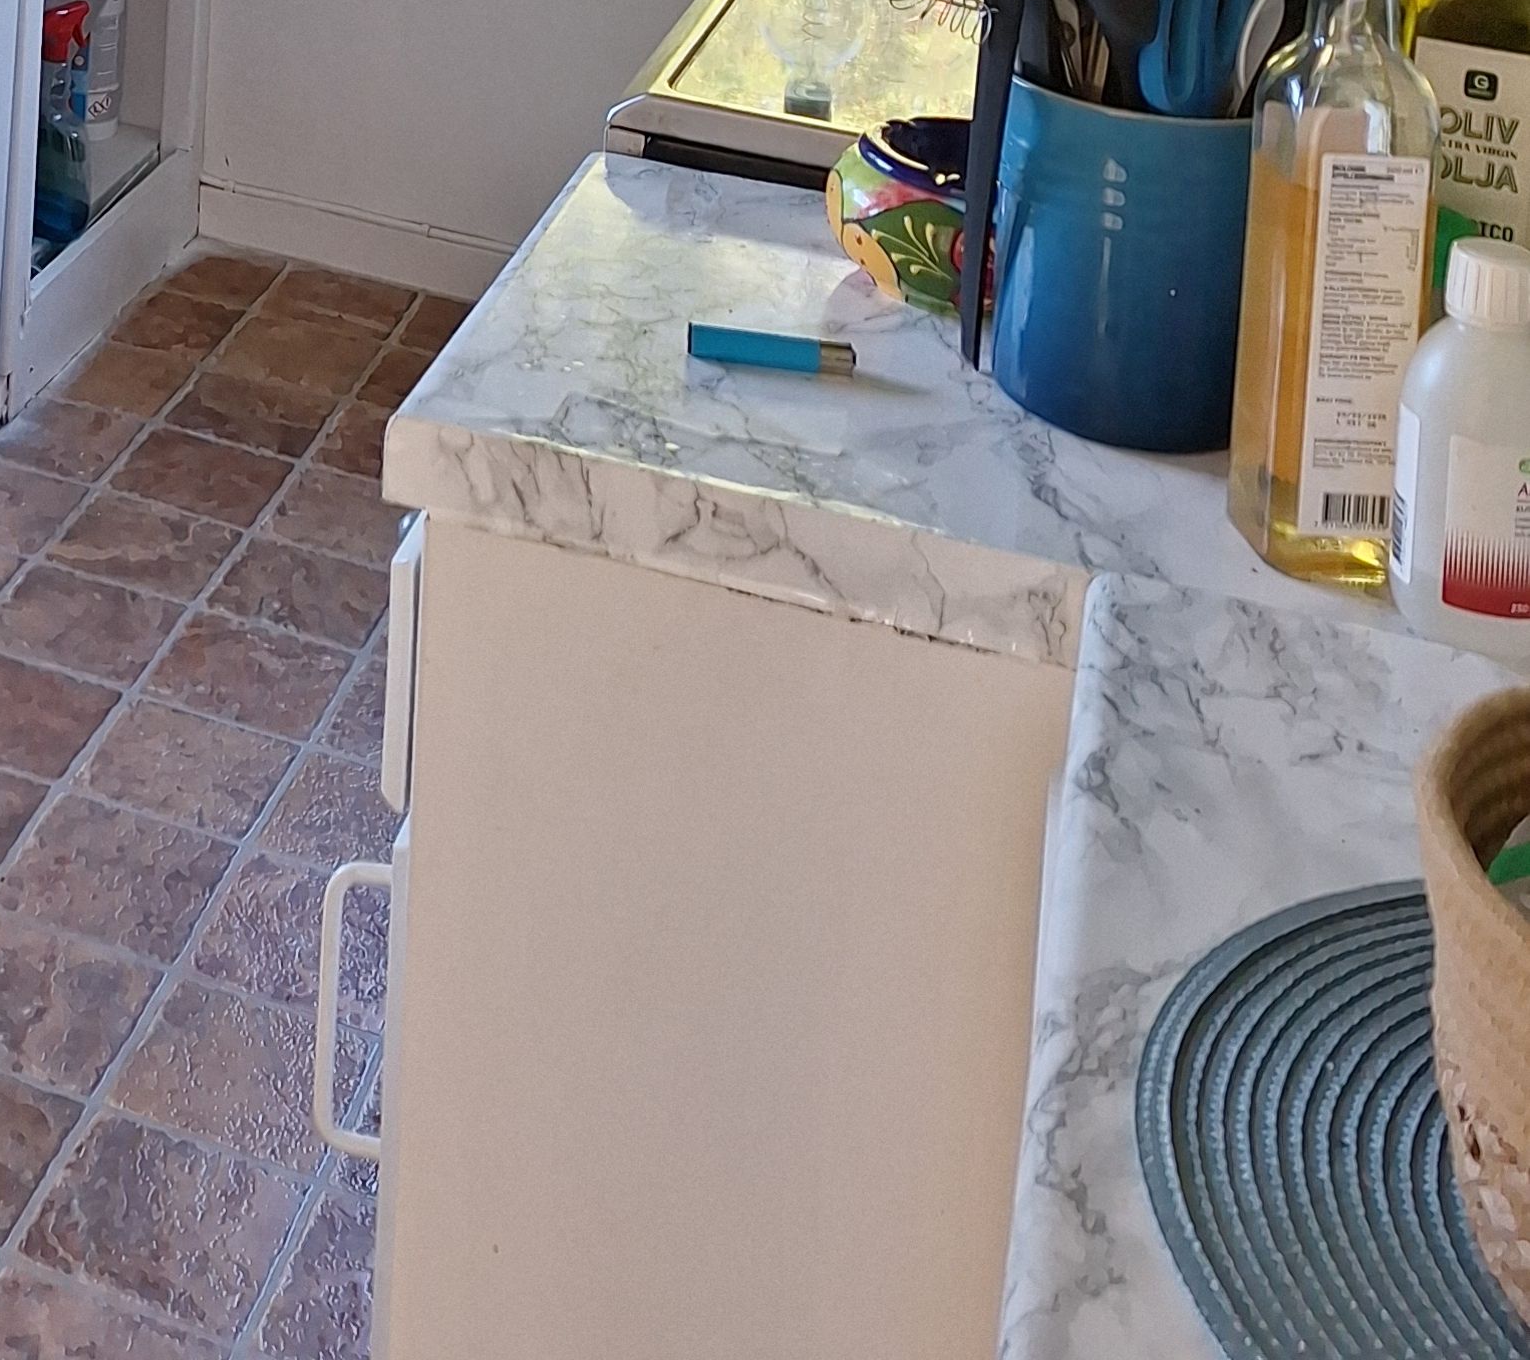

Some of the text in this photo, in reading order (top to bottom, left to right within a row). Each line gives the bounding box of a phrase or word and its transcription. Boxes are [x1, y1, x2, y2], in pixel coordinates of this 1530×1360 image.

[1440, 106, 1520, 145] OLIV
[1442, 139, 1518, 160] TRA VIRGIN
[1472, 219, 1514, 243] ICO
